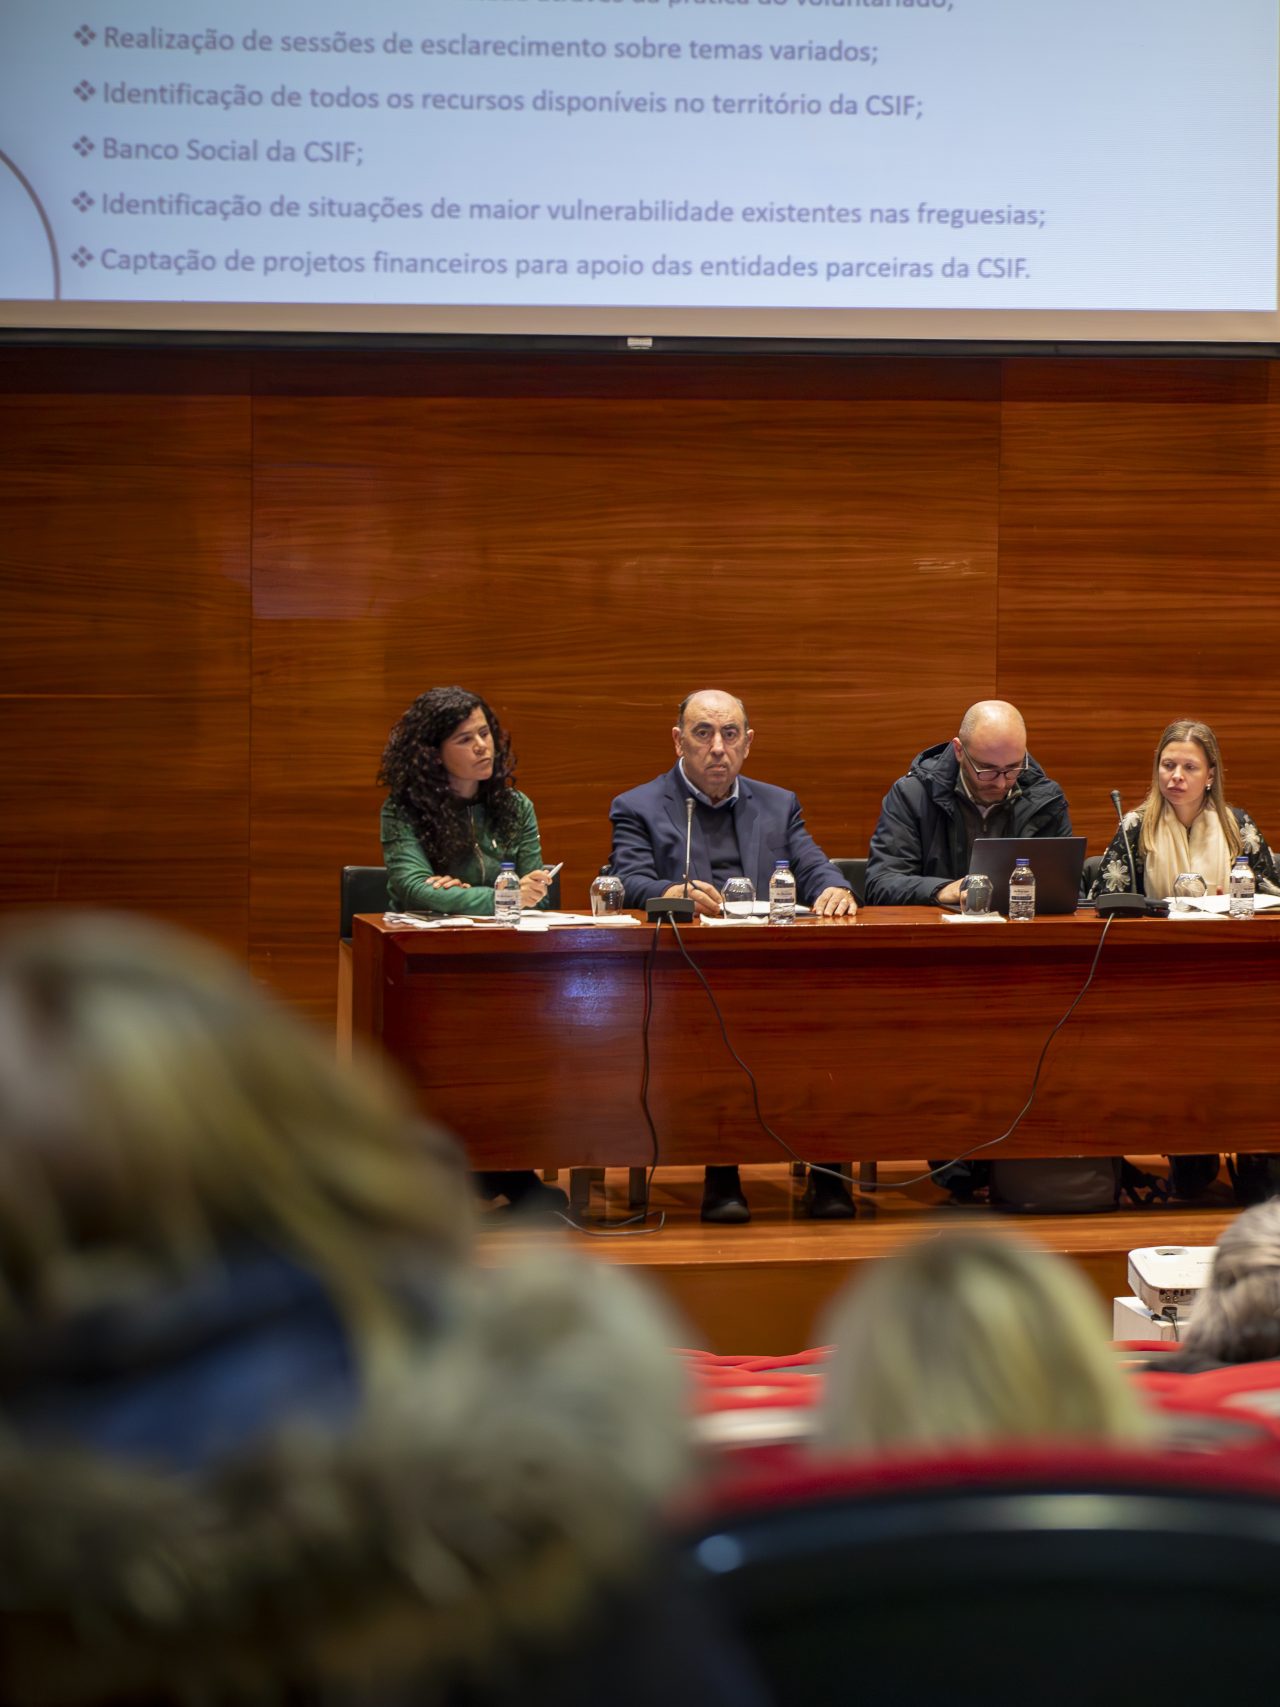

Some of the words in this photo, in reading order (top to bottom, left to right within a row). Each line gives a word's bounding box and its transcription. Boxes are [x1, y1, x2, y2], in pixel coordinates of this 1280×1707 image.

[104, 26, 235, 55] Realização
[242, 29, 273, 52] de
[281, 31, 375, 54] sessões
[382, 32, 413, 54] de
[420, 33, 607, 58] esclarecimento
[614, 36, 682, 59] sobre
[689, 40, 763, 60] temas
[769, 39, 878, 65] variados;
[104, 81, 263, 111] Identificação
[271, 84, 302, 107] de
[309, 86, 379, 108] todos
[386, 92, 414, 109] os
[422, 92, 525, 111] recursos
[532, 89, 667, 116] disponíveis
[675, 97, 705, 113] no
[712, 92, 822, 115] território
[829, 93, 858, 115] da
[865, 95, 923, 120] CSIF;
[103, 137, 179, 161] Banco
[186, 138, 258, 162] Social
[266, 140, 296, 162] da
[304, 141, 363, 166] CSIF;
[103, 192, 262, 221] Identificação
[269, 194, 300, 217] de
[308, 196, 423, 223] situações
[431, 197, 461, 219] de
[469, 199, 541, 220] maior
[547, 198, 734, 222] vulnerabilidade
[742, 202, 862, 223] existentes
[870, 207, 910, 224] nas
[917, 202, 1046, 229] freguesias;
[101, 248, 217, 275] Captação
[224, 249, 255, 271] de
[263, 251, 365, 277] projetos
[373, 250, 508, 274] financeiros
[516, 258, 568, 278] para
[577, 255, 644, 280] apoio
[652, 254, 693, 276] das
[700, 254, 818, 277] entidades
[826, 257, 934, 282] parceiras
[941, 256, 970, 278] da
[977, 257, 1031, 279] CSIF.
